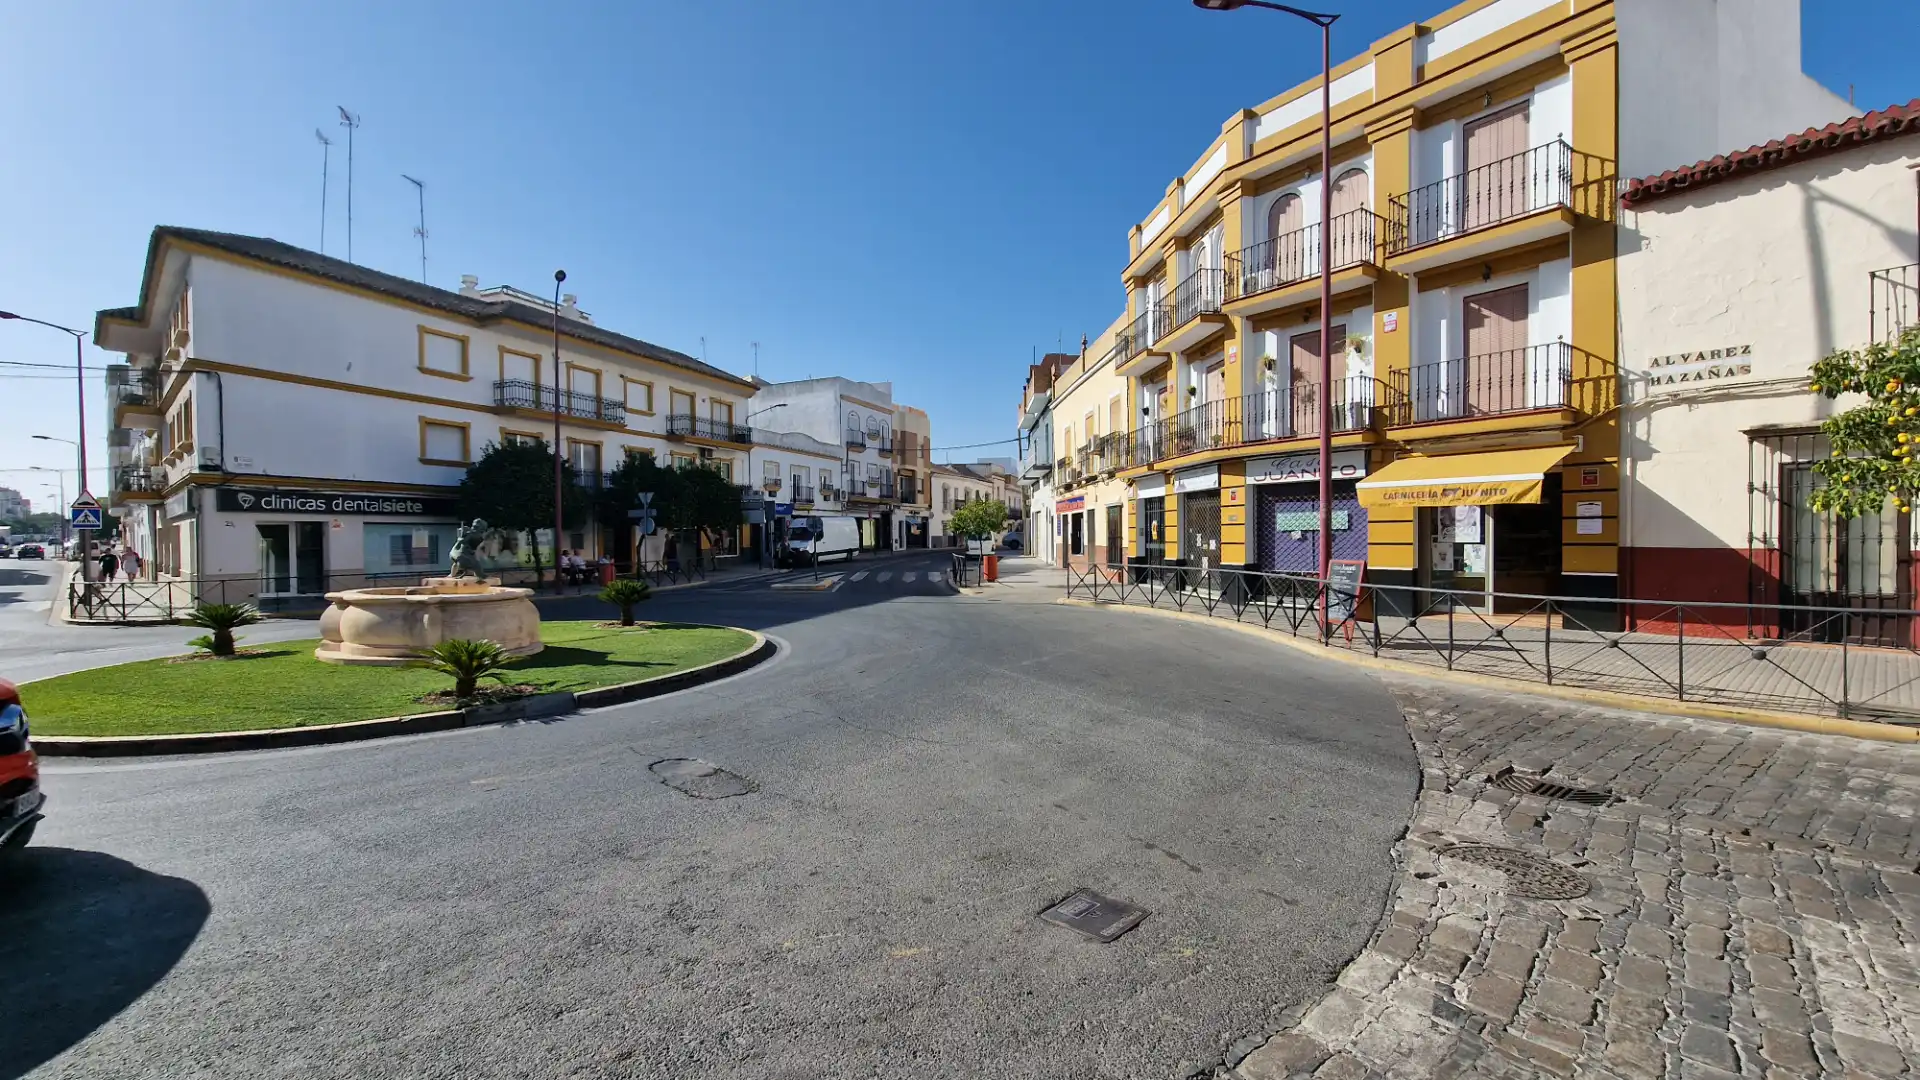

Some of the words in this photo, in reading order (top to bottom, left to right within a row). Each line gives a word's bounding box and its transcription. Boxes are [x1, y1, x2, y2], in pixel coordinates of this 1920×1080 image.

[1650, 345, 1751, 368] ALVAREZ
[1651, 365, 1751, 387] HAZAÑAS
[1253, 464, 1357, 482] JUANIO
[261, 494, 326, 511] clinicas
